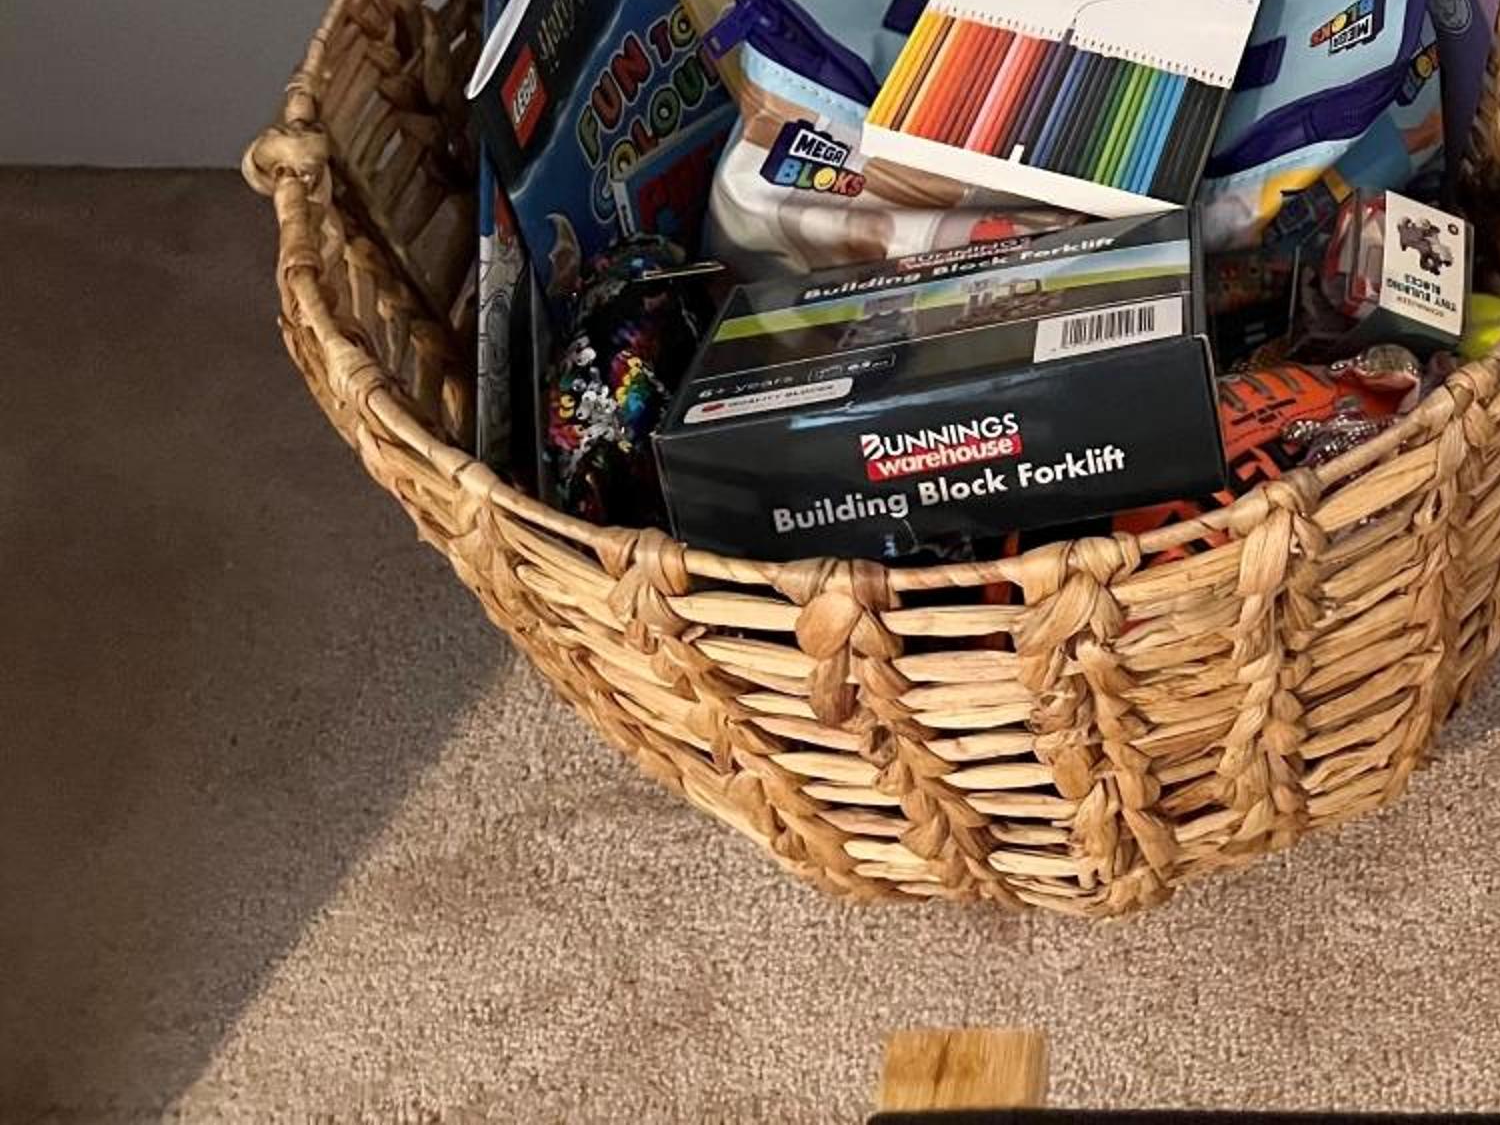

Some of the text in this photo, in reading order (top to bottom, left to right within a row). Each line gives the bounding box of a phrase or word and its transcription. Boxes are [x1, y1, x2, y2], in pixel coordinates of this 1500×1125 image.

[511, 62, 538, 125] LEGO
[577, 5, 697, 170] FUN TO
[793, 132, 845, 164] MEGA
[774, 157, 865, 197] BLOKS
[804, 236, 1116, 300] Building Block Forklift
[861, 412, 1019, 460] BUNNINGS
[876, 435, 1015, 476] warehouse
[773, 446, 1126, 535] Building Block Forklift
